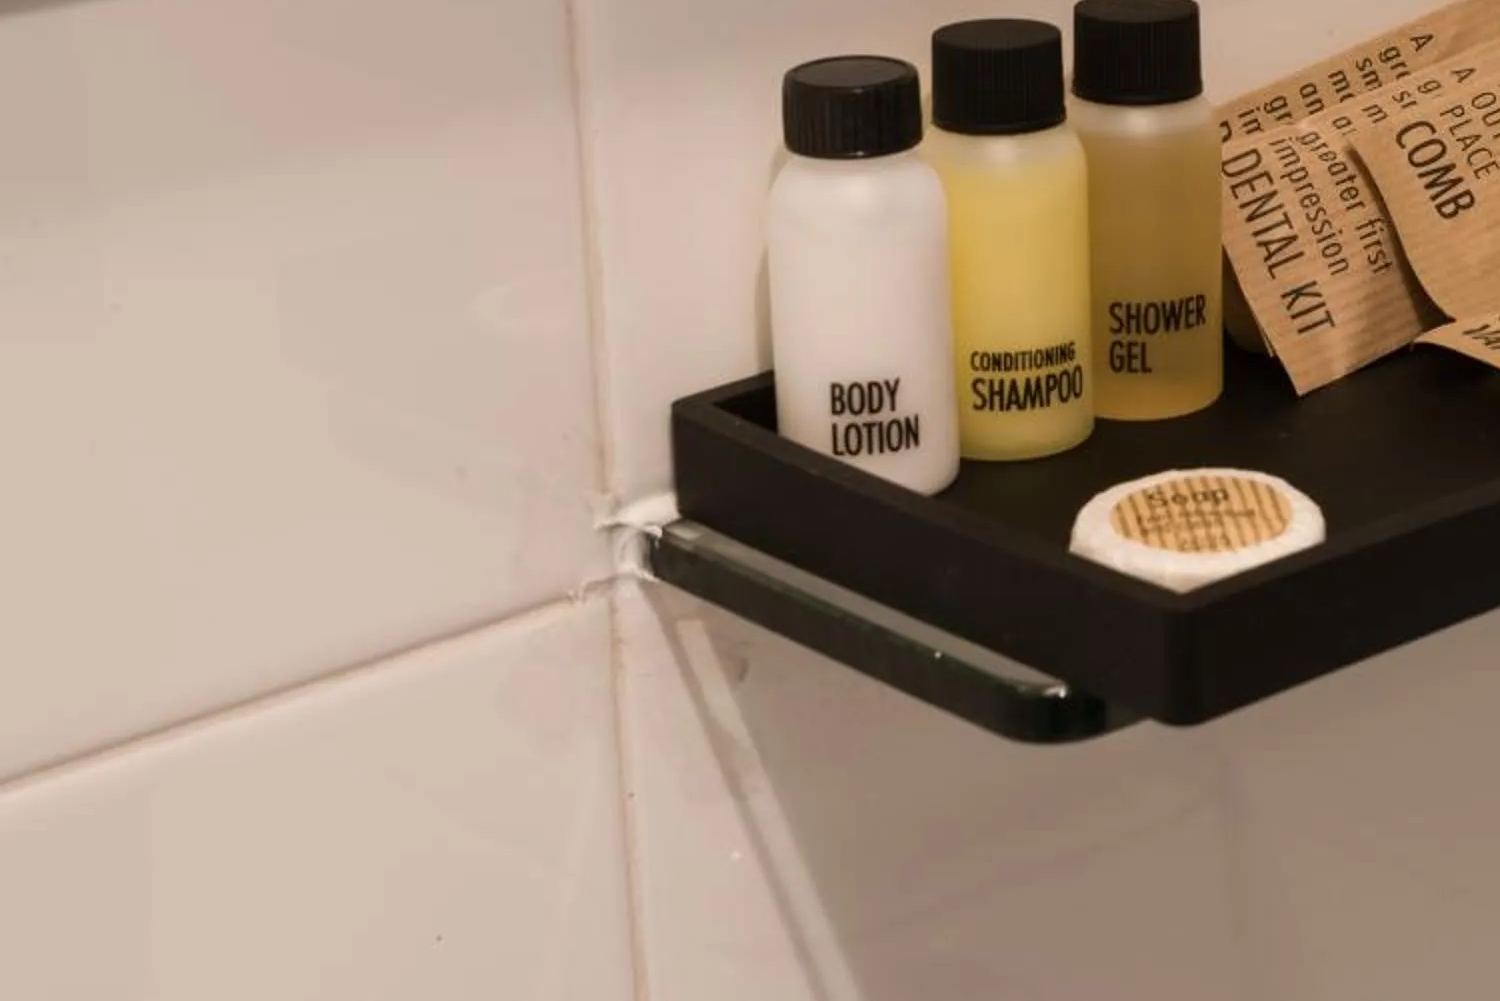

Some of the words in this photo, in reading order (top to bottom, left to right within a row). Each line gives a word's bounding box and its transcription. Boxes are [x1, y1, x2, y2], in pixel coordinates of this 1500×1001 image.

[1439, 104, 1500, 180] PLACE
[1395, 120, 1476, 220] COMB
[1269, 136, 1349, 276] impression
[1221, 148, 1305, 280] DENTAL
[1280, 280, 1336, 335] KIT
[1355, 217, 1393, 274] first
[1108, 294, 1208, 336] SHOWER
[970, 342, 1076, 373] CONDITIONING
[1108, 340, 1153, 375] GEL
[830, 378, 901, 417] BODY
[971, 365, 1084, 412] SHAMPOO
[832, 415, 921, 458] LOTION
